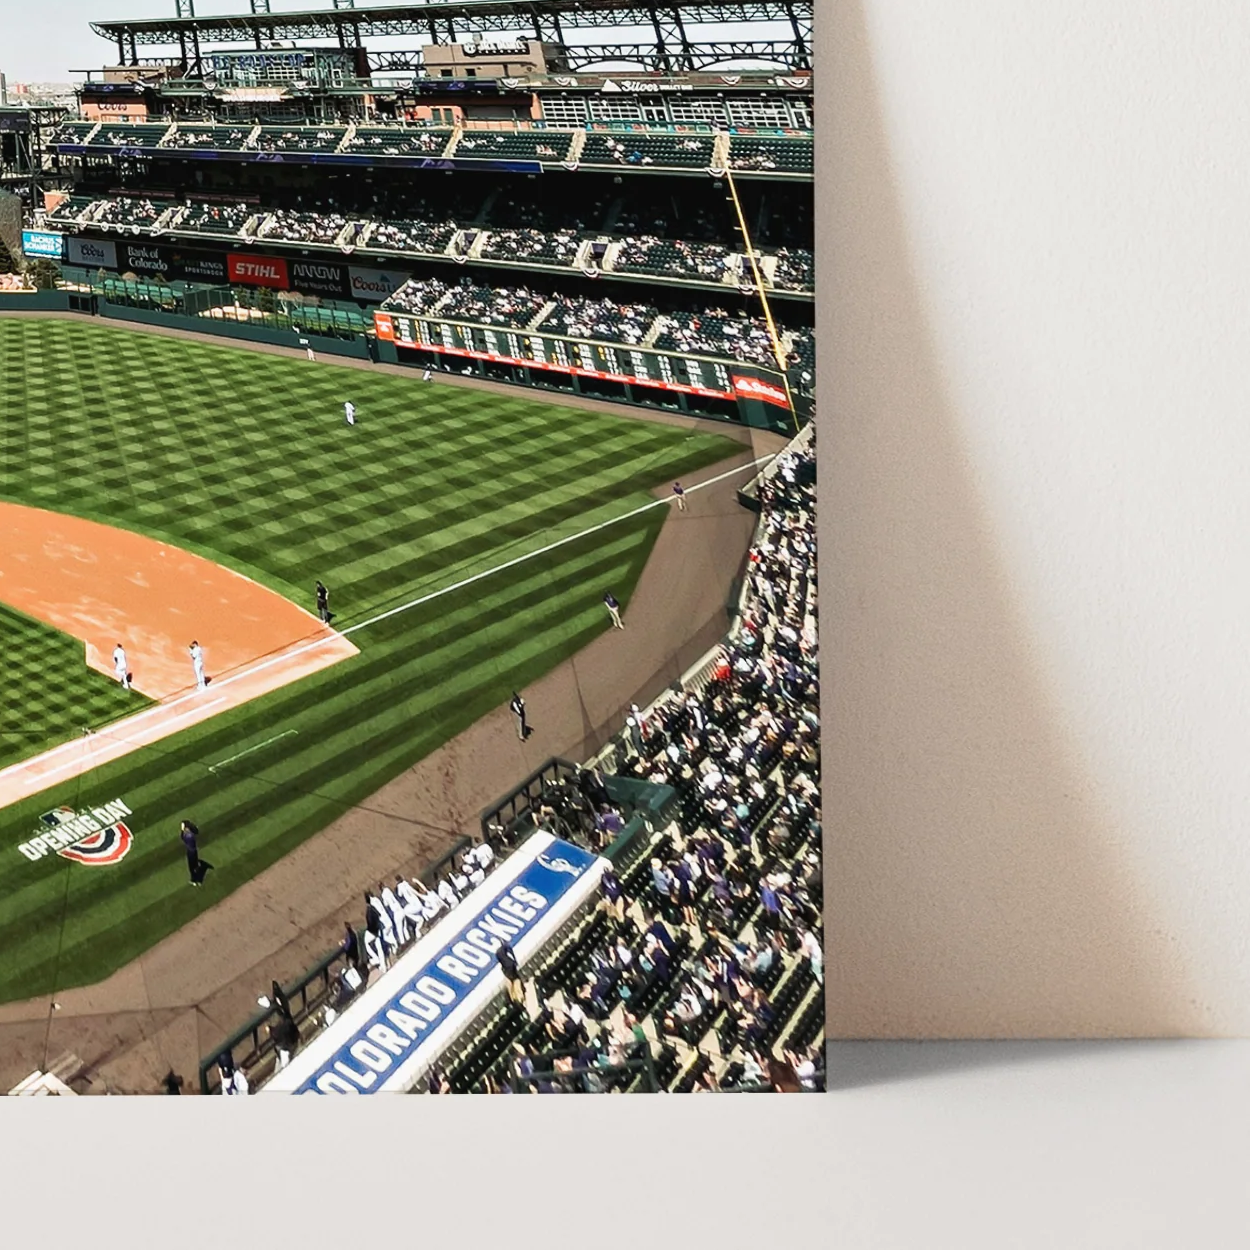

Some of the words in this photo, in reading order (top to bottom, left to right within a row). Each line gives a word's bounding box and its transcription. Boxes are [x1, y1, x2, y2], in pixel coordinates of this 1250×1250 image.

[621, 80, 659, 92] Silver
[128, 245, 149, 258] Bank
[150, 248, 159, 259] of
[129, 256, 169, 271] Colorado
[235, 261, 281, 279] STIHL
[294, 278, 309, 289] Five
[352, 275, 387, 293] Coors
[18, 814, 102, 861] OPENING
[91, 798, 133, 825] DAY
[302, 975, 457, 1095] OLORADO
[436, 884, 548, 985] ROCKIES
